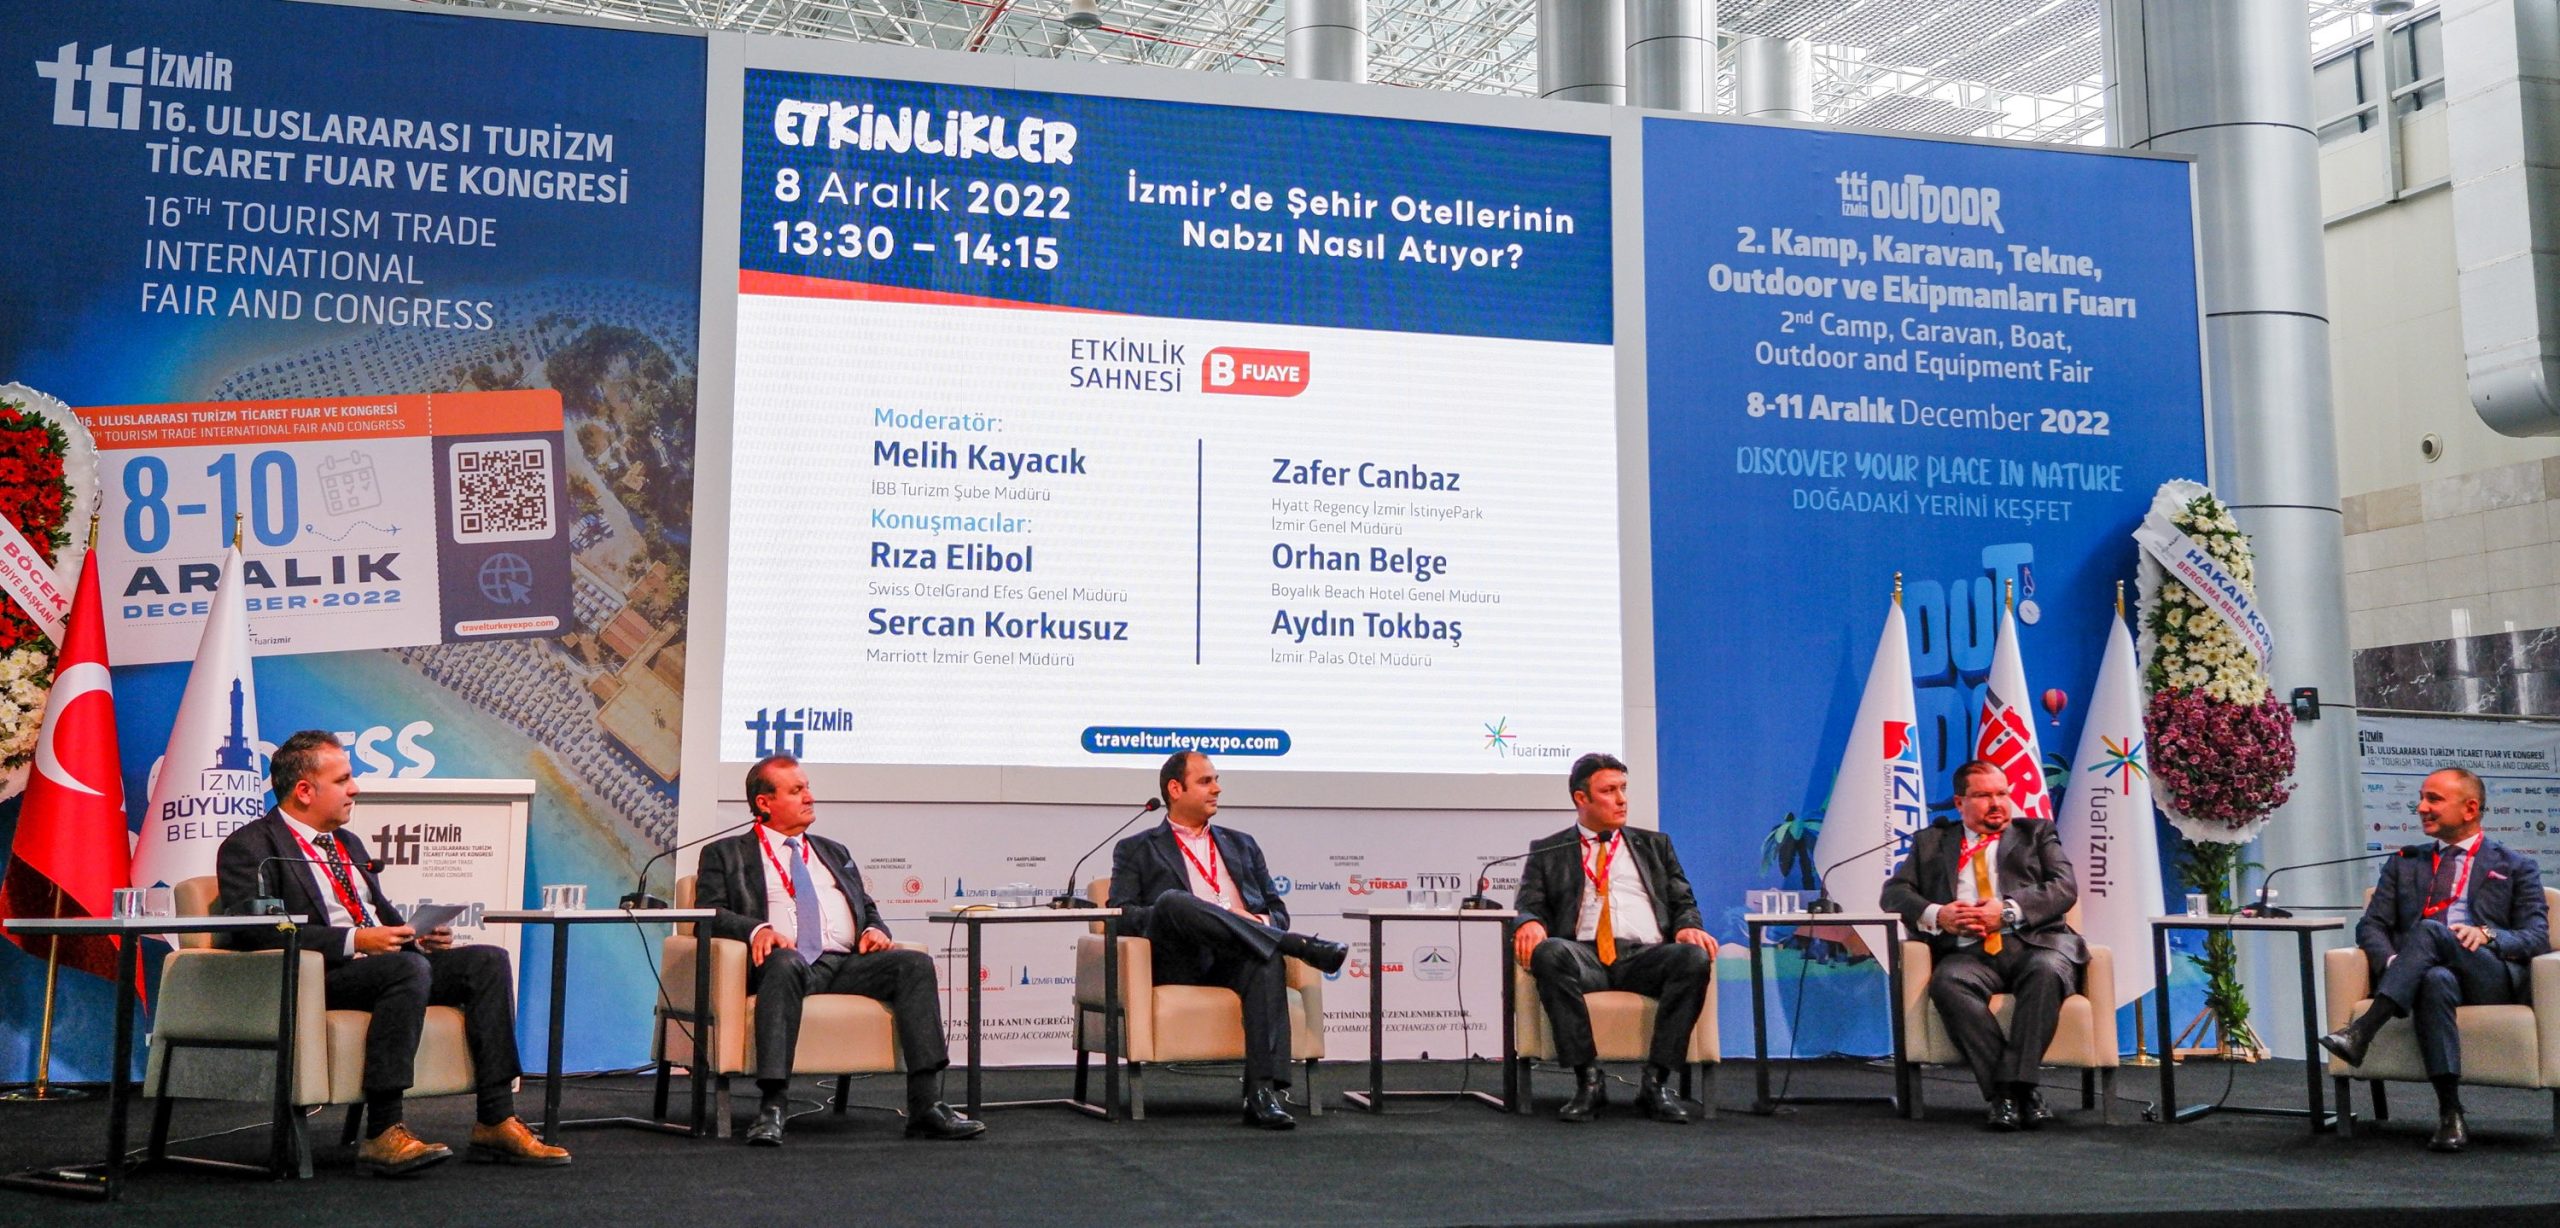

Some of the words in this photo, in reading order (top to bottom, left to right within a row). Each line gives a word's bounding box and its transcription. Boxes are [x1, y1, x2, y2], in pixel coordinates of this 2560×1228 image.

[150, 46, 233, 91] İZMİR
[149, 100, 196, 133] 16.
[206, 104, 471, 153] ULUSLARARASI
[483, 123, 613, 163] TURİZM
[774, 98, 1077, 165] ETKİNLİKLER
[145, 136, 295, 181] TİCARET
[305, 153, 395, 189] FUAR
[406, 161, 448, 192] VE
[459, 166, 628, 204] KONGRESİ
[774, 167, 801, 202] 8
[818, 171, 951, 212] Aralık
[967, 180, 1070, 219] 2022
[1287, 187, 1378, 219] Şehir
[1391, 195, 1574, 234] Otellerinin
[1842, 201, 1868, 218] İZMİR
[1871, 174, 2005, 234] OUTDOOR
[222, 201, 379, 240] TOURISM
[391, 212, 497, 247] TRADE
[145, 239, 424, 285] INTERNATIONAL
[773, 220, 894, 261] 13:30
[954, 232, 1058, 270] 14:15
[1183, 220, 1283, 252] Nabzı
[1299, 228, 1385, 260] Nasıl
[1399, 236, 1523, 272] Atıyor?
[1736, 226, 1765, 254] 2.
[1772, 227, 1867, 267] Kamp,
[1873, 234, 2003, 275] Karavan,
[2008, 244, 2101, 282] Tekne,
[141, 282, 217, 316] FAIR
[228, 287, 302, 320] AND
[314, 293, 494, 331] CONGRESS
[1708, 263, 1838, 298] Outdoor
[1841, 278, 1877, 301] ve
[1883, 275, 2057, 313] Ekipmanları
[2063, 287, 2136, 318] Fuarı
[1071, 337, 1185, 365] ETKİNLİK
[1780, 310, 1813, 333] 2nd
[1820, 312, 1894, 345] Camp,
[1901, 317, 2004, 349] Caravan,
[2011, 324, 2072, 354] Boat,
[1070, 366, 1182, 392] SAHNESİ
[1210, 353, 1235, 387] B
[1242, 363, 1300, 382] FUAYE
[1755, 341, 1858, 369] Outdoor
[1864, 349, 1908, 372] and
[1915, 350, 2043, 383] Equipment
[2049, 358, 2093, 383] Fair
[99, 412, 188, 427] ULUSLARARASI
[192, 409, 236, 422] TURİZM
[241, 408, 288, 421] TİCARET
[291, 407, 321, 419] FUAR
[324, 407, 338, 417] VE
[341, 402, 398, 417] KONGRESİ
[105, 429, 158, 442] TOURISM
[162, 428, 197, 439] TRADE
[201, 424, 290, 438] INTERNATIONAL
[294, 423, 317, 433] FAIR
[321, 422, 344, 432] AND
[347, 419, 406, 432] CONGRESS
[874, 408, 1002, 432] Moderatör:
[1747, 392, 1803, 418] 8-11
[1808, 394, 1895, 424] Aralık
[1901, 399, 2034, 431] December
[2040, 408, 2110, 436] 2022
[874, 440, 957, 469] Melih
[968, 444, 1087, 480] Kayacık
[1272, 458, 1351, 486] Zafer
[1358, 462, 1461, 492] Canbaz
[1737, 446, 1848, 478] DISCOVER
[1855, 451, 1919, 481] YOUR
[1927, 455, 1992, 488] PLACE
[2000, 459, 2024, 488] IN
[2032, 461, 2123, 492] NATURE
[122, 450, 298, 554] 8-10
[871, 480, 896, 496] İBB
[901, 482, 949, 497] Turizm
[954, 484, 990, 502] Şube
[994, 486, 1051, 501] Müdürü
[1272, 498, 1309, 515] Hyatt
[1313, 499, 1369, 518] Regency
[1793, 486, 1909, 514] DOĞADAKİ
[1915, 493, 1988, 519] YERİNİ
[1994, 498, 2072, 526] KEŞFET
[871, 508, 1032, 537] Konuşmacılar:
[1308, 519, 1346, 533] Genel
[1351, 521, 1402, 536] Müdürü
[3, 541, 68, 611] BÖCEK
[123, 552, 401, 597] ARALIK
[870, 541, 936, 570] Rıza
[947, 543, 1033, 572] Elibol
[1272, 542, 1360, 572] Orhan
[1370, 547, 1447, 583] Belge
[868, 582, 910, 597] Swiss
[914, 583, 989, 599] OtelGrand
[994, 584, 1023, 600] Efes
[1028, 586, 1068, 601] Genel
[1073, 588, 1128, 603] Müdürü
[1271, 583, 1320, 601] Boyalık
[1324, 585, 1365, 600] Beach
[1369, 586, 1405, 601] Hotel
[1408, 588, 1445, 602] Genel
[1449, 590, 1501, 604] Müdürü
[2176, 561, 2221, 602] BERGAMA
[2185, 549, 2248, 609] HAKAN
[123, 595, 307, 619] DECEBER
[462, 619, 554, 632] travelturkeyexpo.com
[868, 607, 975, 637] Sercan
[985, 611, 1129, 641] Korkusuz
[1271, 609, 1354, 644] Aydın
[1363, 612, 1462, 648] Tokbaş
[867, 649, 928, 663] Marriott
[973, 650, 1014, 666] Genel
[1019, 652, 1074, 667] Müdürü
[1309, 650, 1344, 665] Palas
[1348, 651, 1376, 666] Otel
[1380, 652, 1432, 667] Müdürü
[808, 707, 853, 732] İZMİR
[1094, 731, 1279, 753] travelturkeyexpo.com
[1512, 743, 1571, 758] fuarizmir
[424, 823, 462, 842] İZMİR
[2090, 786, 2114, 898] fuarizmir
